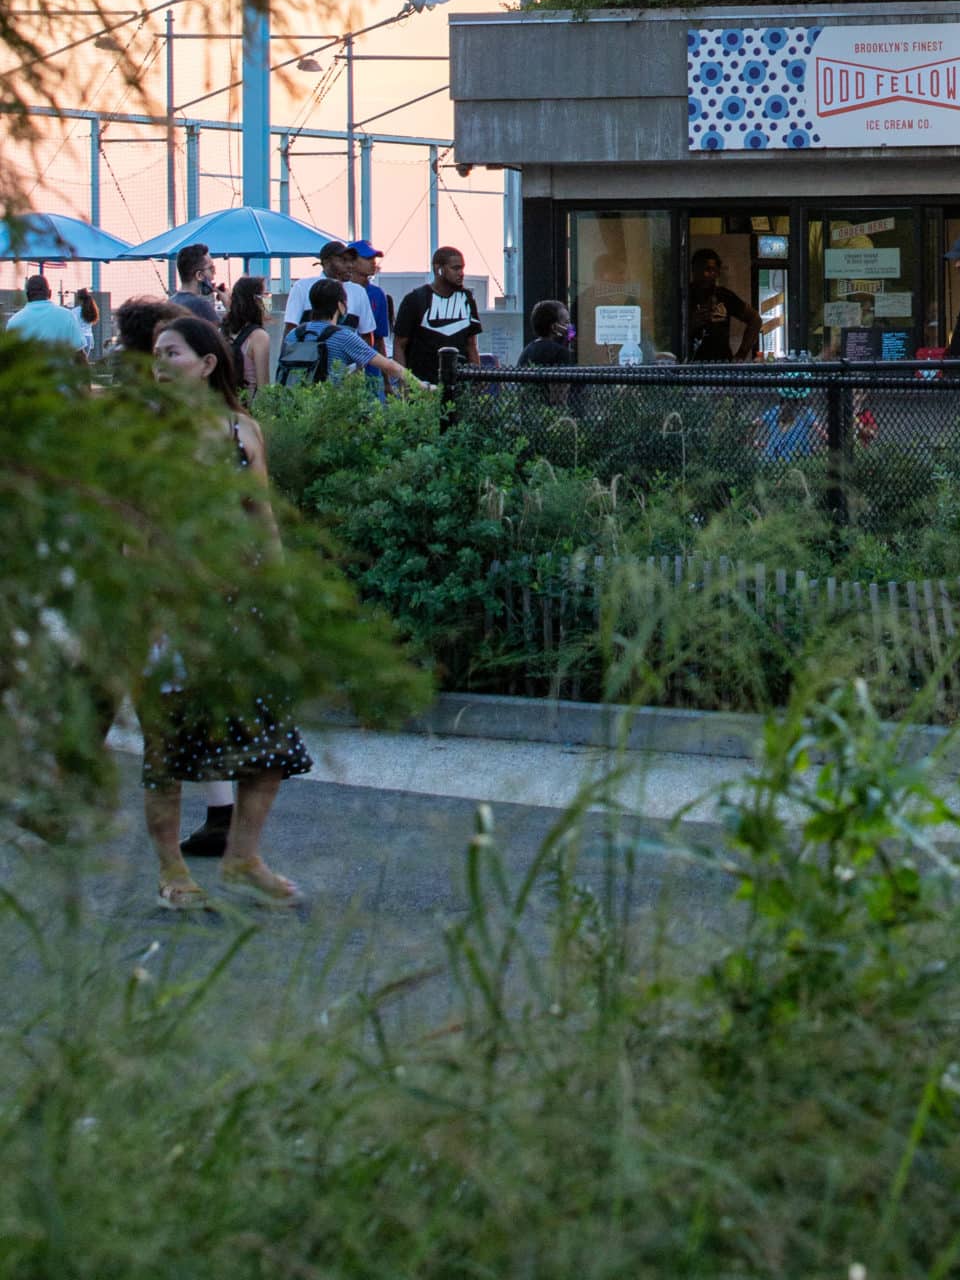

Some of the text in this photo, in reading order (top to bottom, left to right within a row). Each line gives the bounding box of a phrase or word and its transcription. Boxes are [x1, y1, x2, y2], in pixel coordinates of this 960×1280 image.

[854, 40, 943, 54] BROOKLYN'S FINEST
[866, 118, 933, 131] ICE CREAM CO.
[428, 291, 470, 320] NIK
